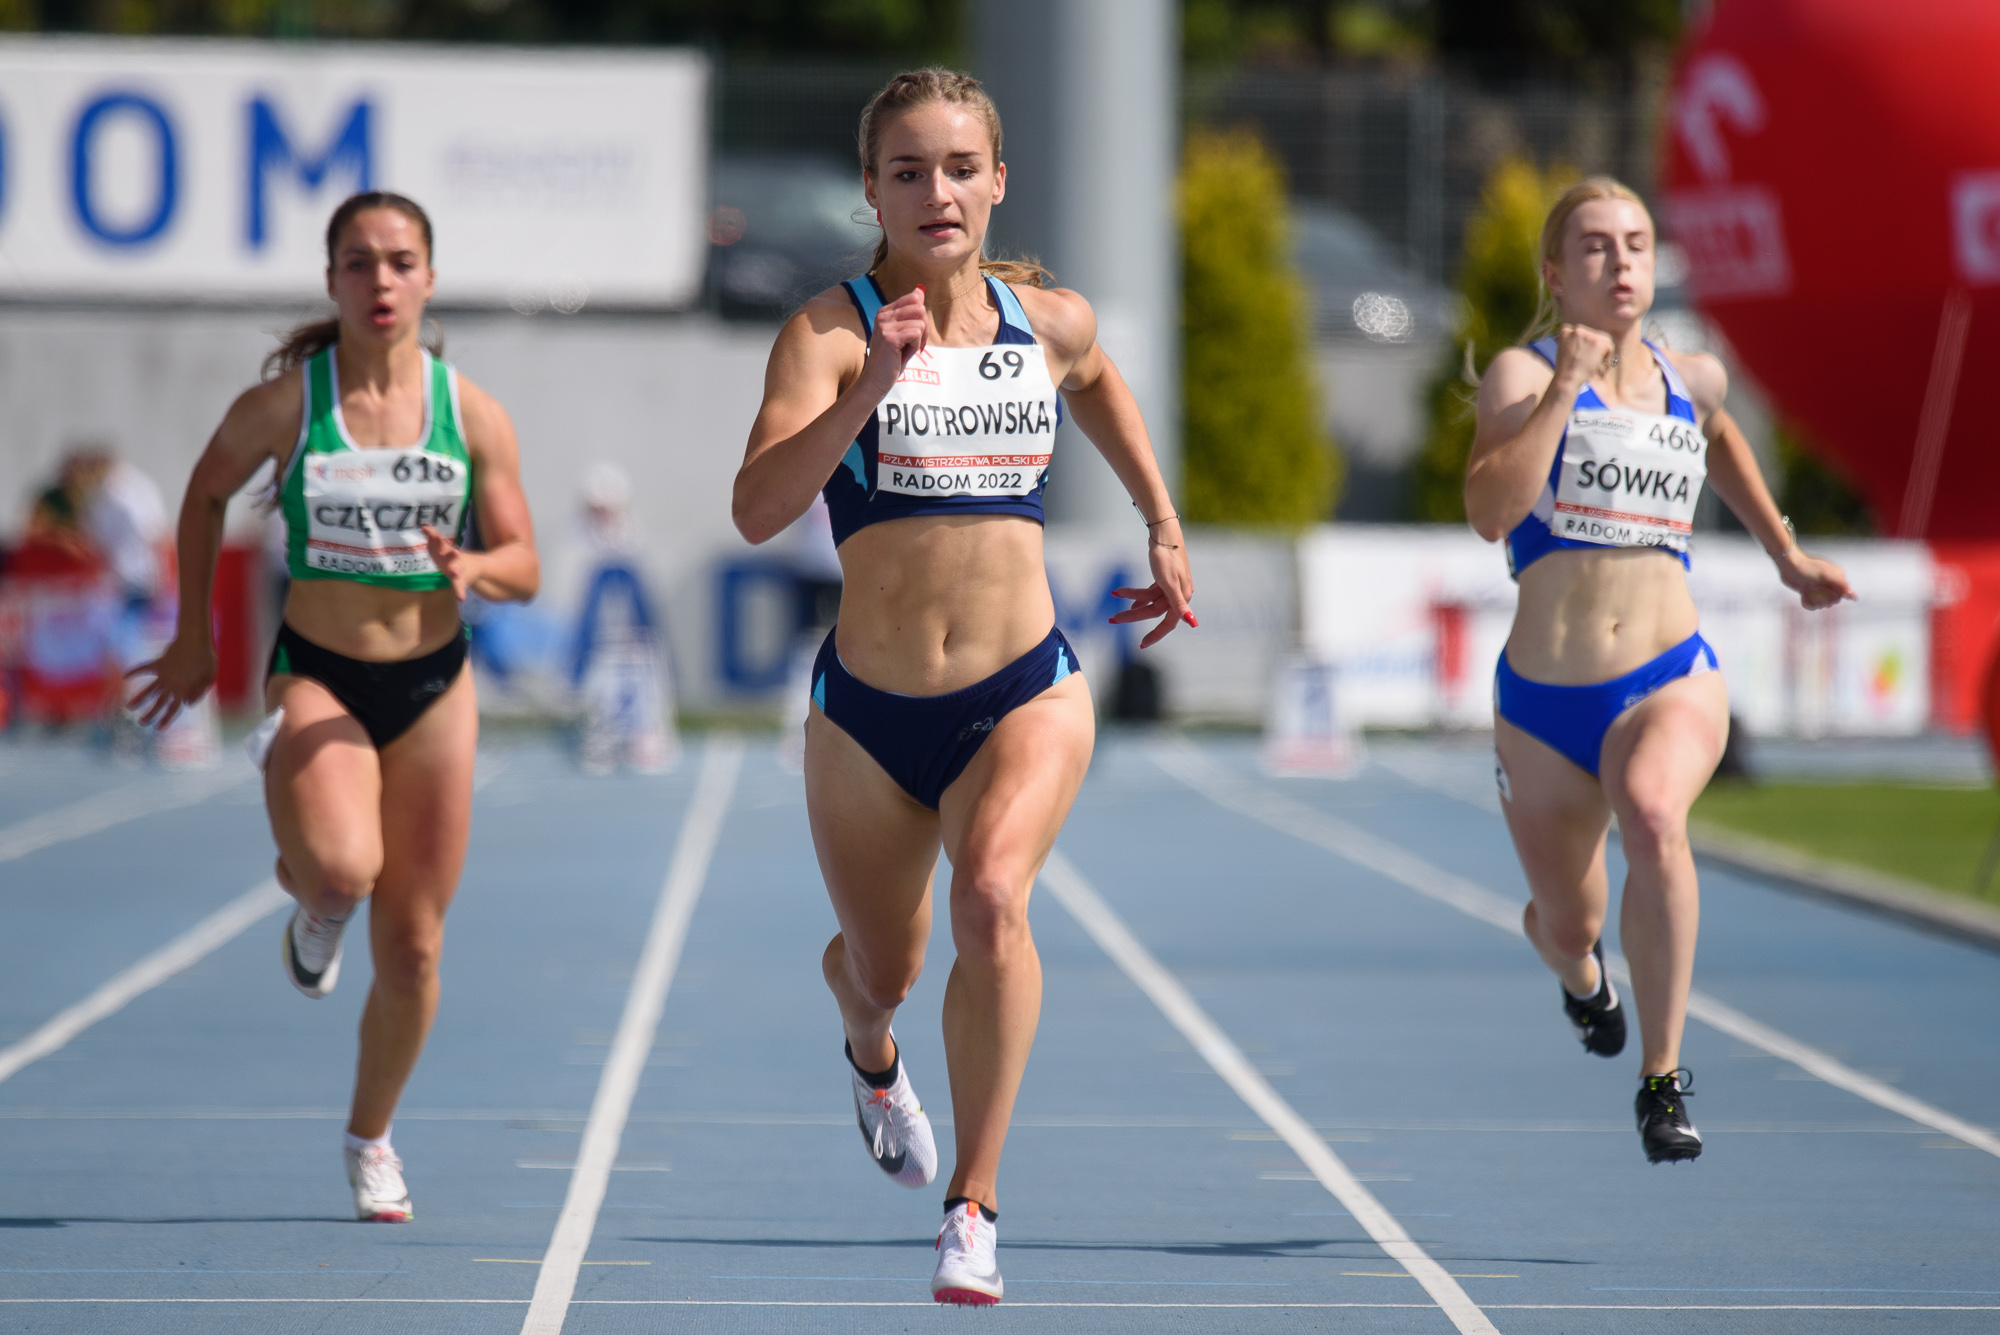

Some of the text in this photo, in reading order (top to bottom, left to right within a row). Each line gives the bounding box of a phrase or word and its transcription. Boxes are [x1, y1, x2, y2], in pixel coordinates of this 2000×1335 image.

[0, 91, 375, 248] OM
[978, 350, 1024, 381] 69
[886, 401, 1050, 436] PIOTROWSKA
[392, 456, 454, 483] 618
[883, 454, 1050, 467] PZLA MISTRZOSTWA POLSKI U20
[893, 472, 1022, 490] RADOM 2022
[1577, 457, 1689, 504] SÓWKA
[316, 504, 453, 538] CZĘCZEK
[1564, 519, 1631, 542] RADOM
